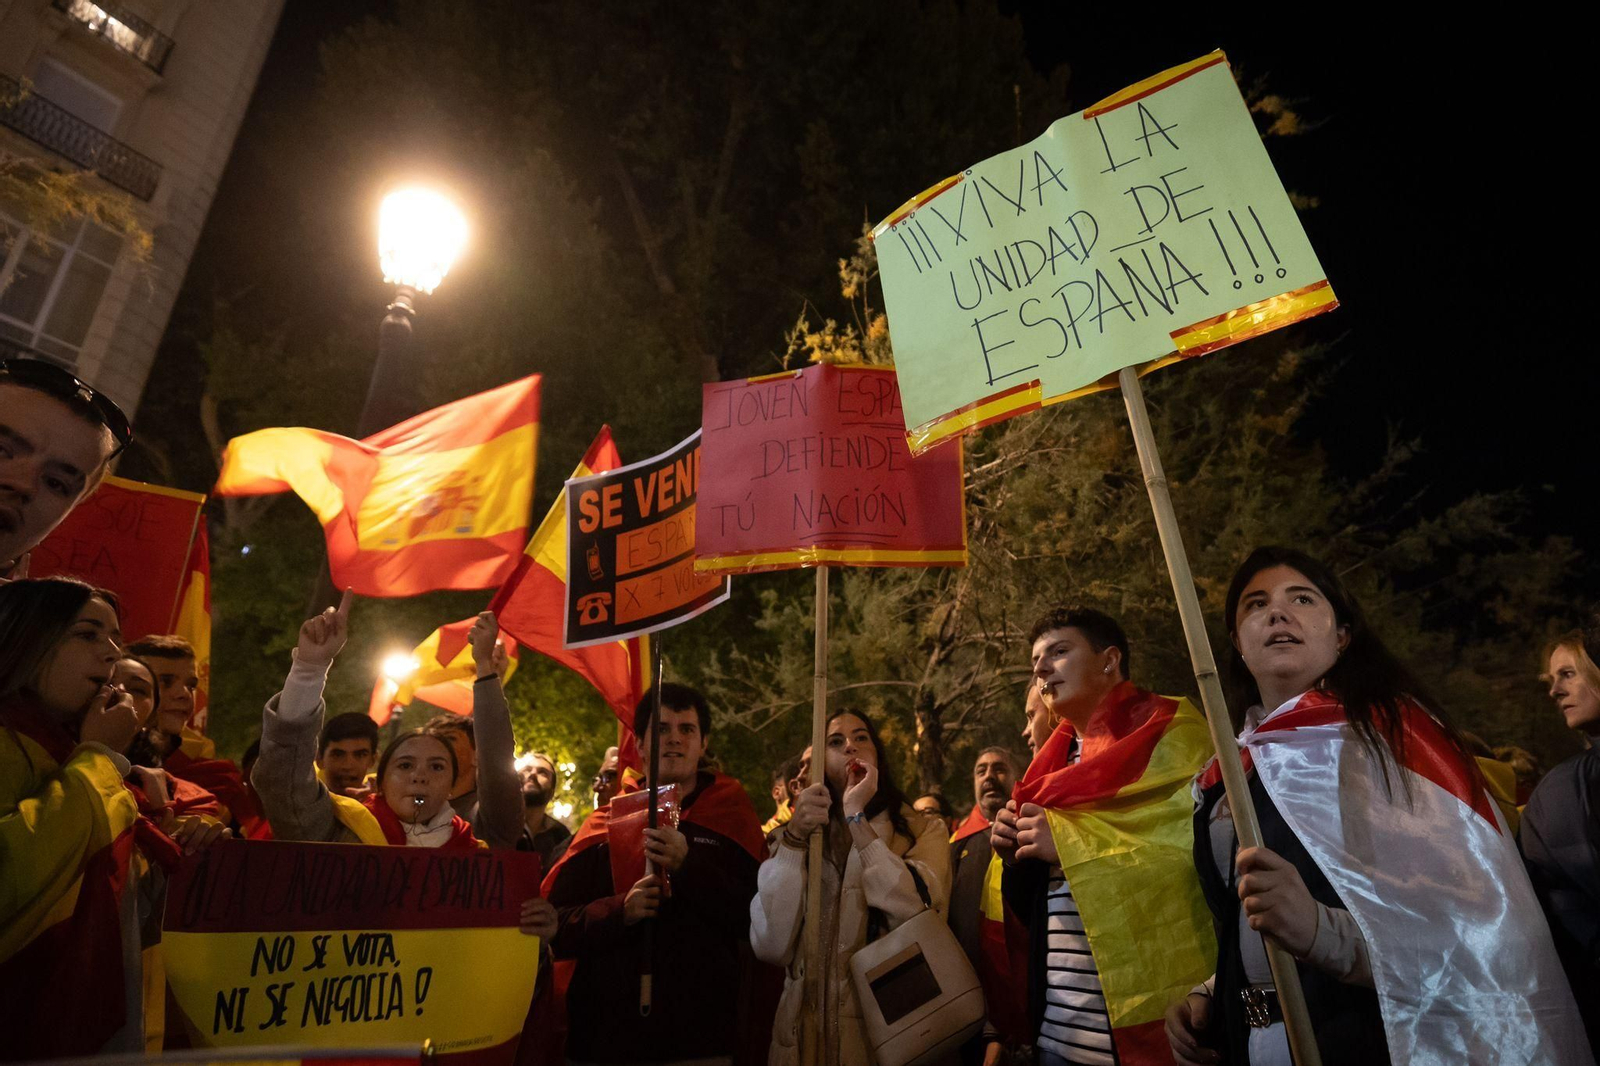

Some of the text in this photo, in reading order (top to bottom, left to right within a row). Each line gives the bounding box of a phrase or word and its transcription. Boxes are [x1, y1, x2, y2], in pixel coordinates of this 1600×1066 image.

[1095, 101, 1179, 173] LA
[950, 167, 1214, 310] UNIDAD DE
[711, 370, 904, 432] JOVEN ESPA
[750, 431, 906, 481] DEFIENDE
[577, 445, 700, 534] SE VEN
[711, 484, 907, 537] TÚ NACIÓN
[627, 511, 695, 568] ESPA
[418, 851, 505, 914] ESPAÑA
[250, 933, 402, 976] NO SE VOTA,
[212, 987, 250, 1036] NI
[258, 982, 295, 1030] SE
